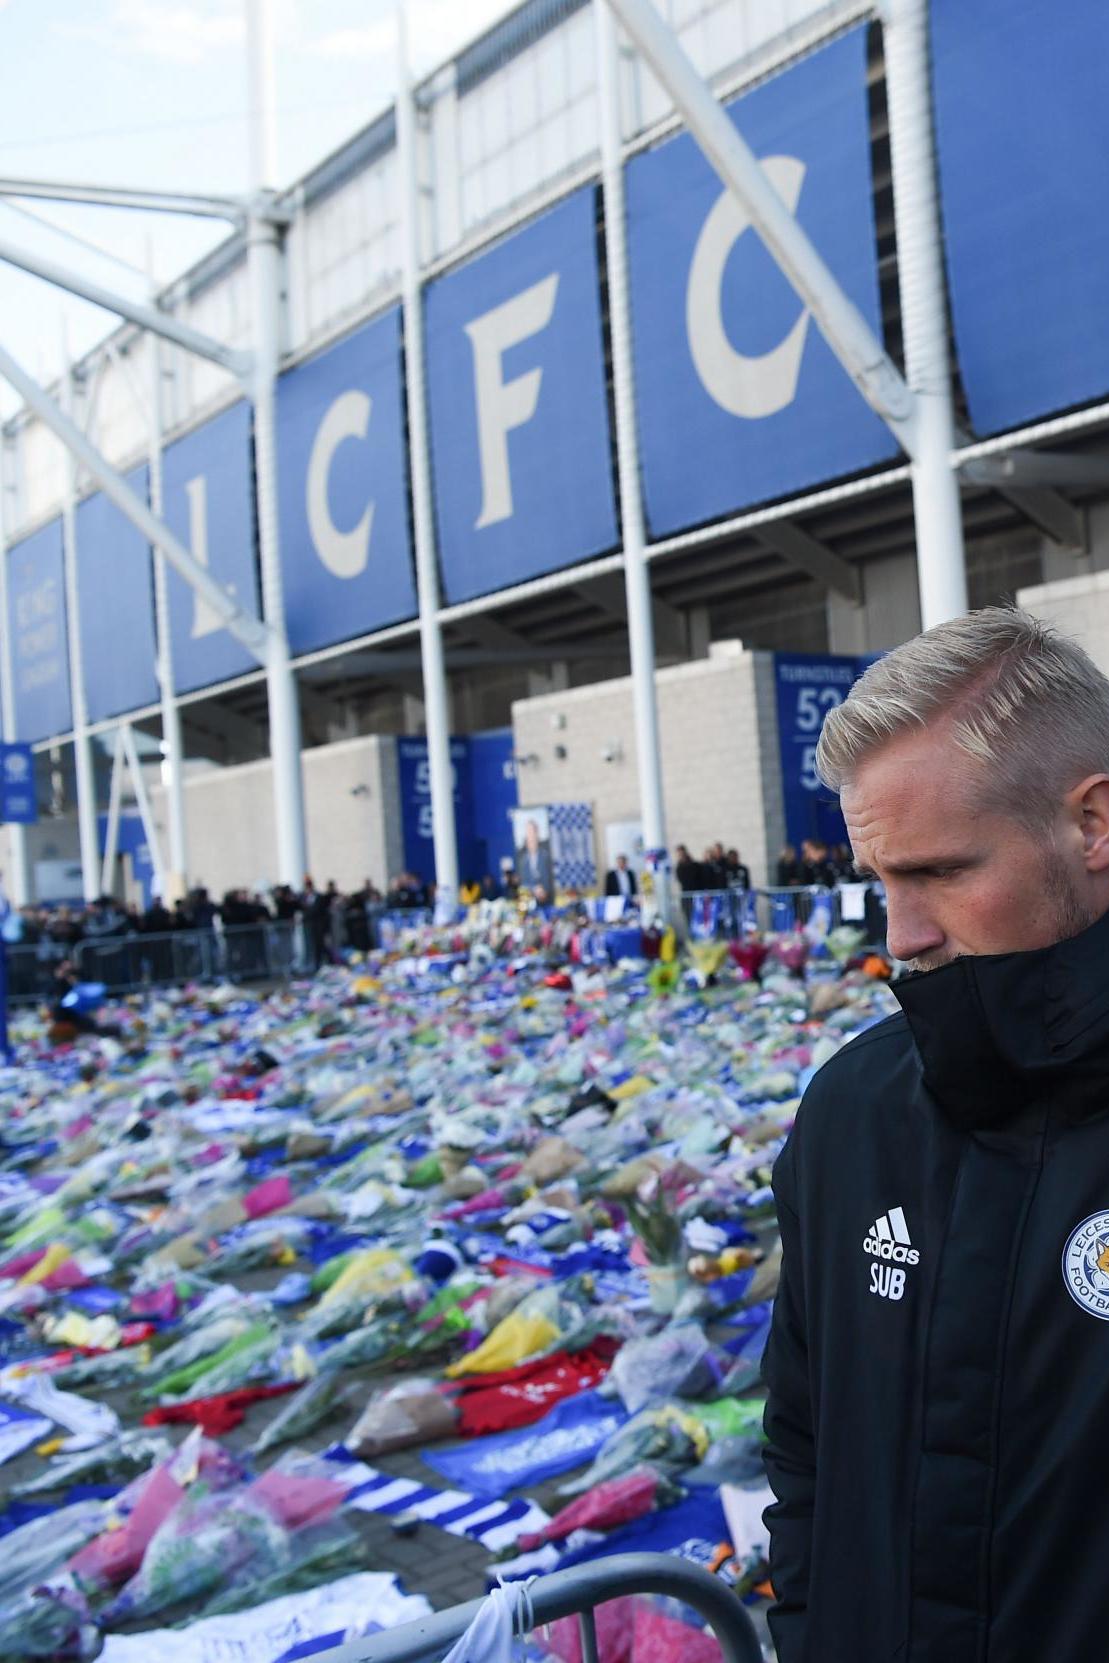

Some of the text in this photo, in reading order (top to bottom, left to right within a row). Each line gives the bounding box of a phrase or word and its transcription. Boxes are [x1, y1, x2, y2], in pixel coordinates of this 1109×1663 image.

[305, 389, 376, 580] C
[463, 271, 560, 531] F
[685, 154, 811, 420] C
[869, 1262, 906, 1301] SUB
